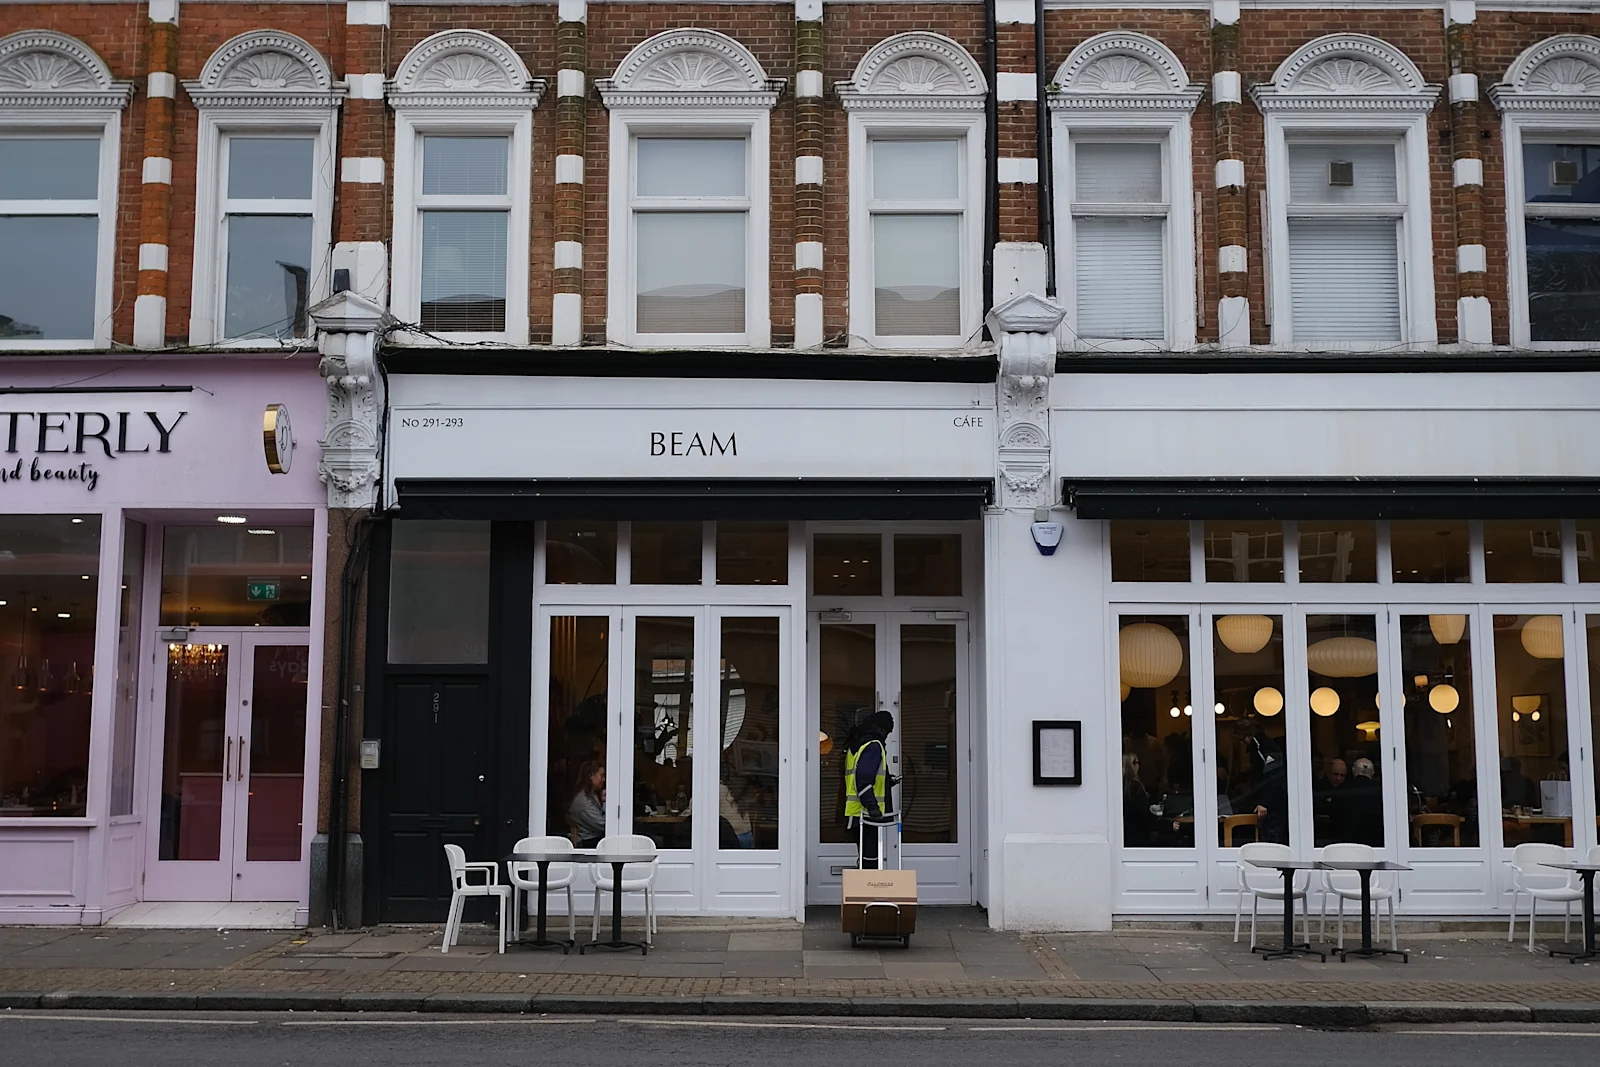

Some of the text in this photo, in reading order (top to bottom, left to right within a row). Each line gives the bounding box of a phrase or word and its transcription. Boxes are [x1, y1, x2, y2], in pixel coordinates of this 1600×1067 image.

[0, 411, 188, 459] TERLY
[422, 417, 464, 428] 291-293
[650, 432, 738, 456] BEAM
[30, 457, 100, 492] beauty
[432, 692, 440, 724] 291
